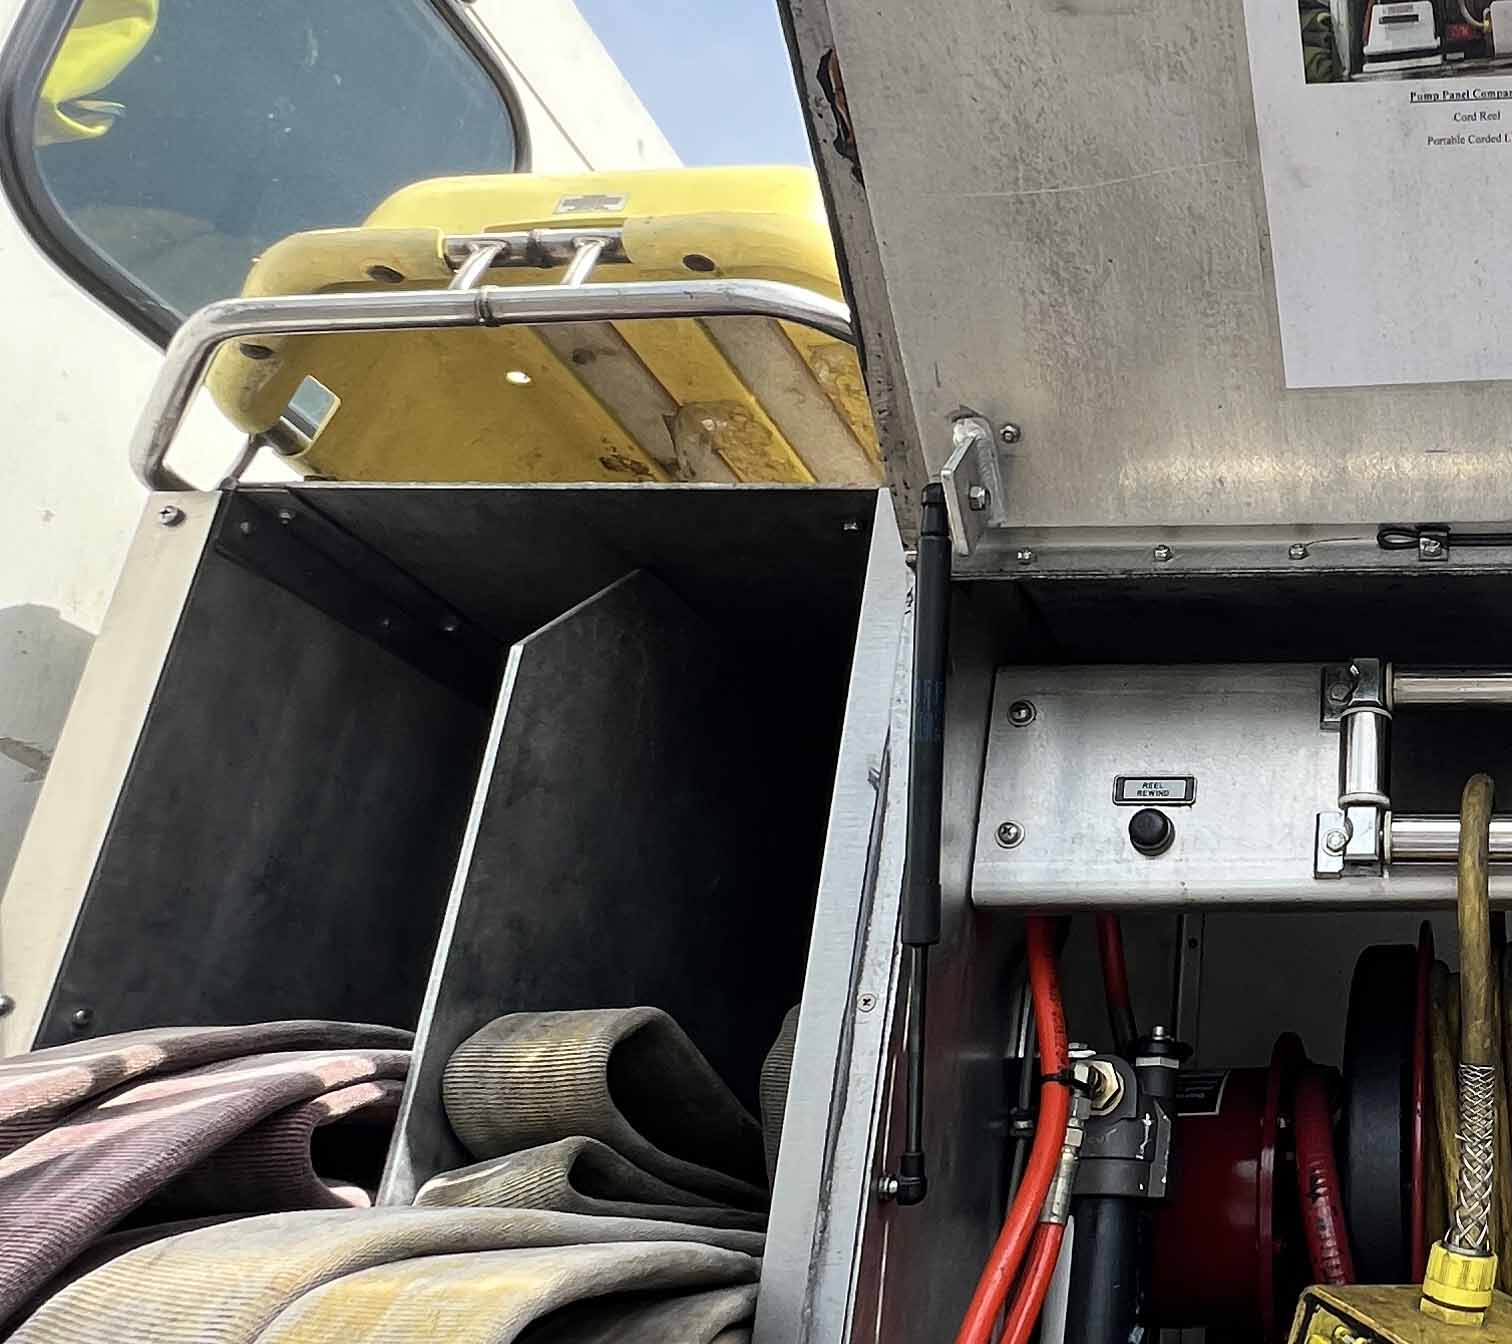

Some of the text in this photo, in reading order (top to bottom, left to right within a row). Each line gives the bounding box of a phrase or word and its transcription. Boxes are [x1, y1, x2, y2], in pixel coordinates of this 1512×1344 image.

[1410, 91, 1439, 103] Pump
[1442, 90, 1470, 101] Panel
[1454, 111, 1501, 122] Cord Reel
[1427, 135, 1465, 146] Portable
[1468, 134, 1501, 144] Corded
